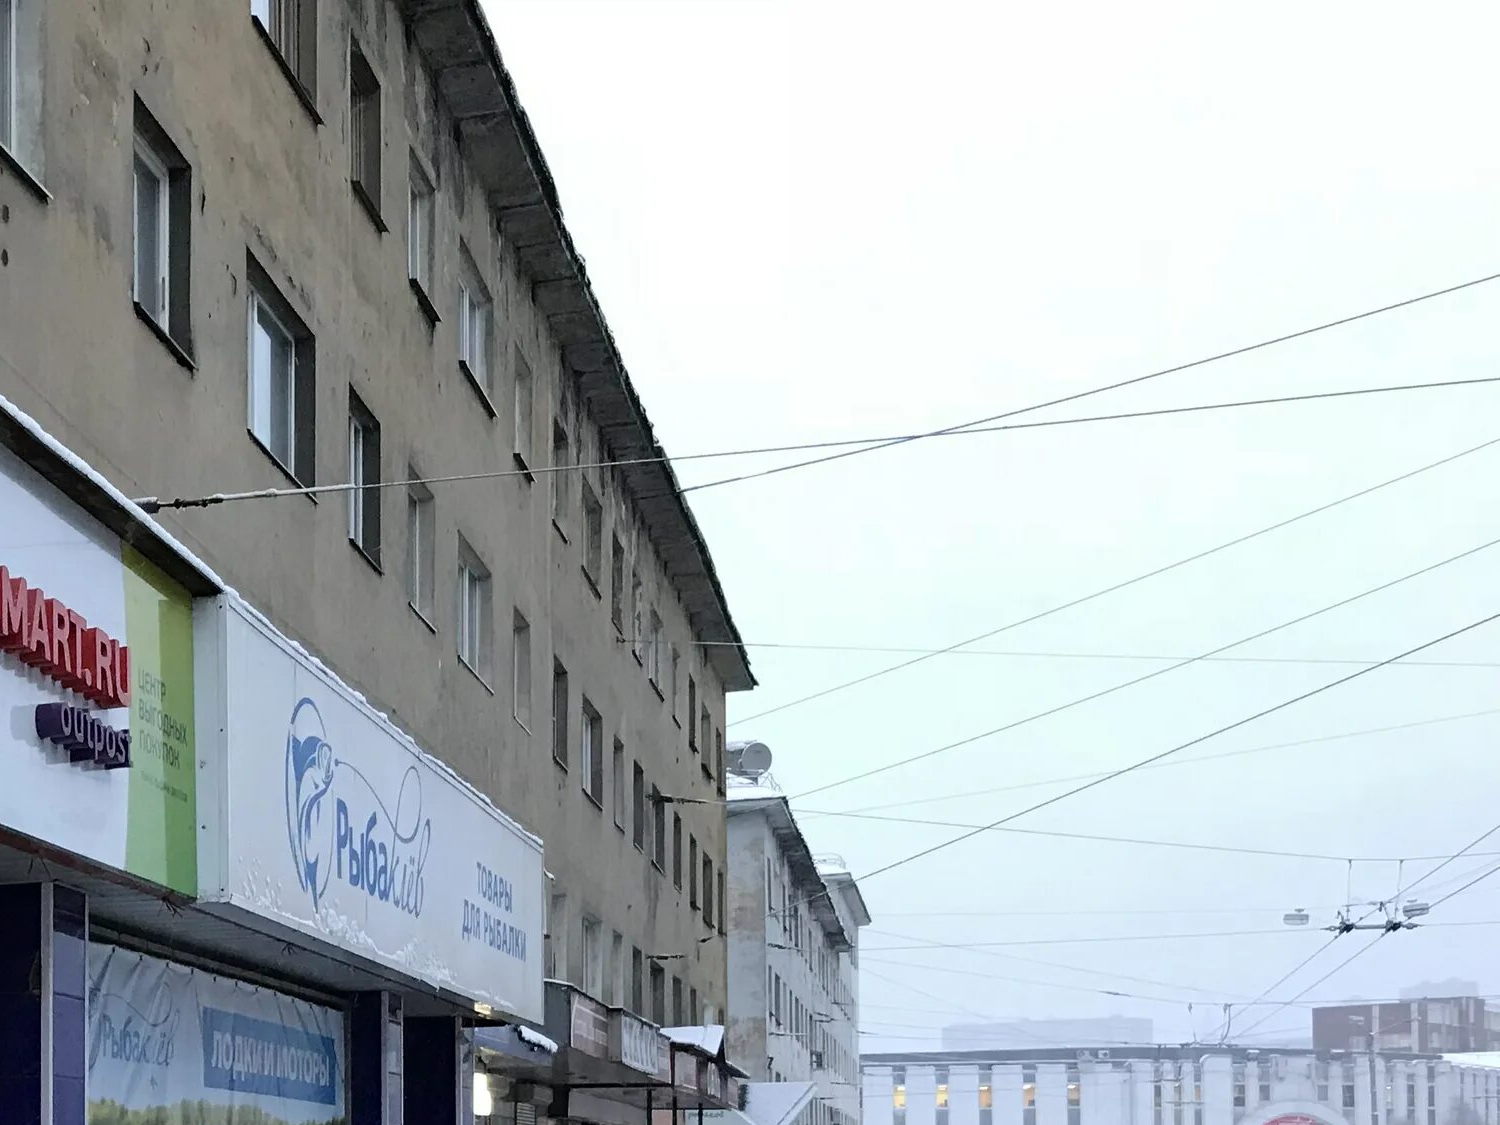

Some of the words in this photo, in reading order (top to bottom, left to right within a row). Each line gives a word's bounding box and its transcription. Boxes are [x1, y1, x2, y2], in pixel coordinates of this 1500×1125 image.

[137, 667, 167, 702] ЦЕНТР
[40, 702, 133, 767] outpost
[138, 698, 188, 747] ВЫГОДНЫХ
[138, 729, 181, 770] ПОКУПОК
[476, 861, 513, 914] ТОВАРЫ
[462, 898, 481, 942] ДЛЯ
[483, 911, 527, 963] РЫБАЛКИ
[211, 1030, 261, 1081] ЛОДКИ
[263, 1040, 275, 1076] И
[276, 1044, 329, 1087] МОТОРЫ
